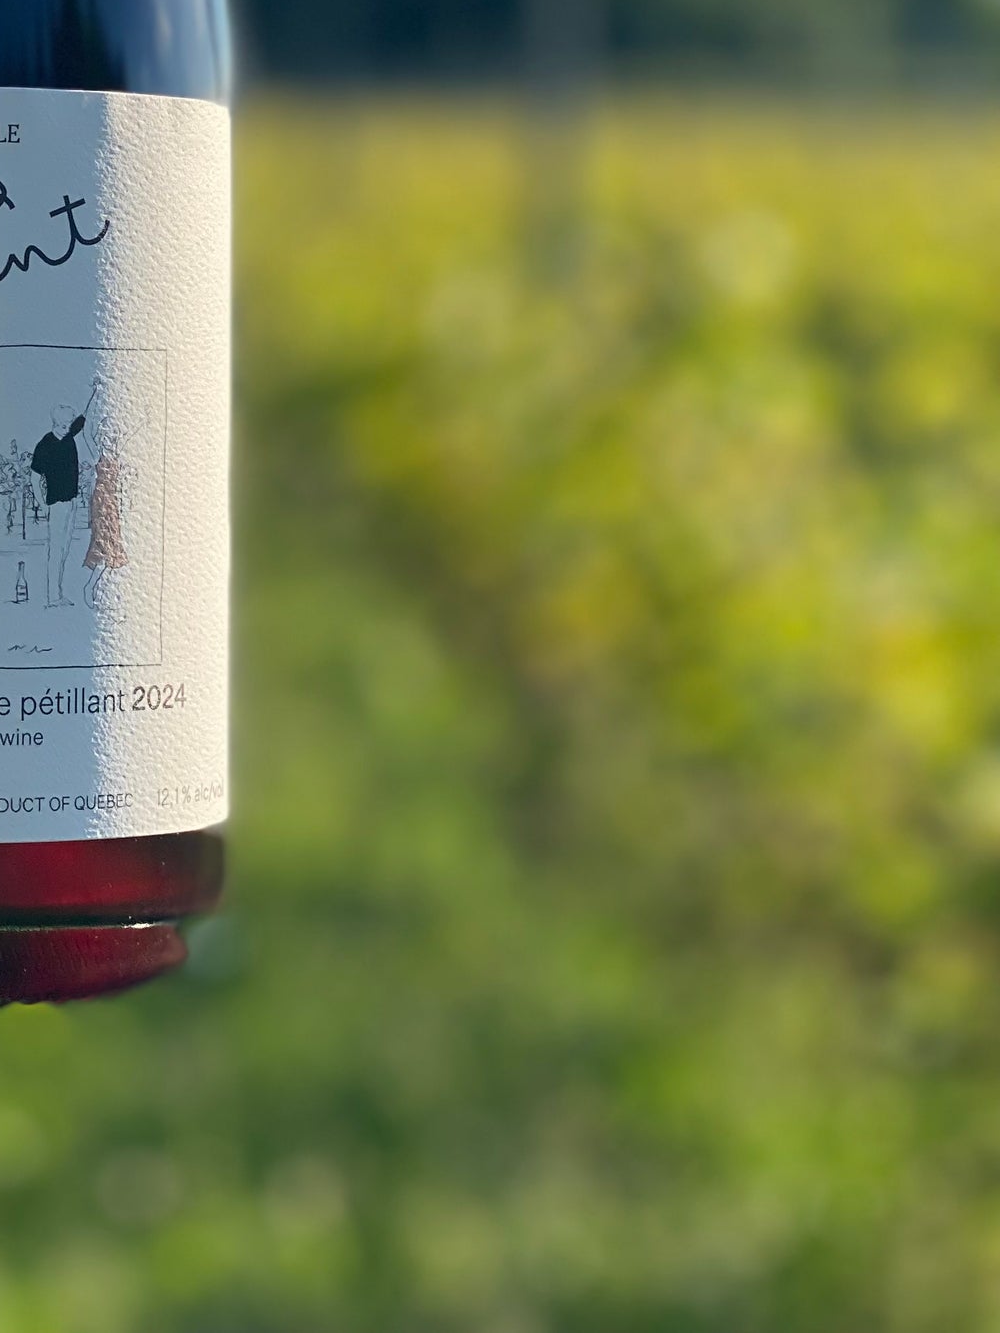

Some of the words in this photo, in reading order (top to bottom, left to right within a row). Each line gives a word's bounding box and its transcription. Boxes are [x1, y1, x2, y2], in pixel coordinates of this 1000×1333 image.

[20, 687, 126, 721] pétillant
[131, 683, 187, 712] 2024
[0, 728, 44, 746] wine
[49, 796, 71, 812] OF
[74, 792, 134, 812] QUEBEC
